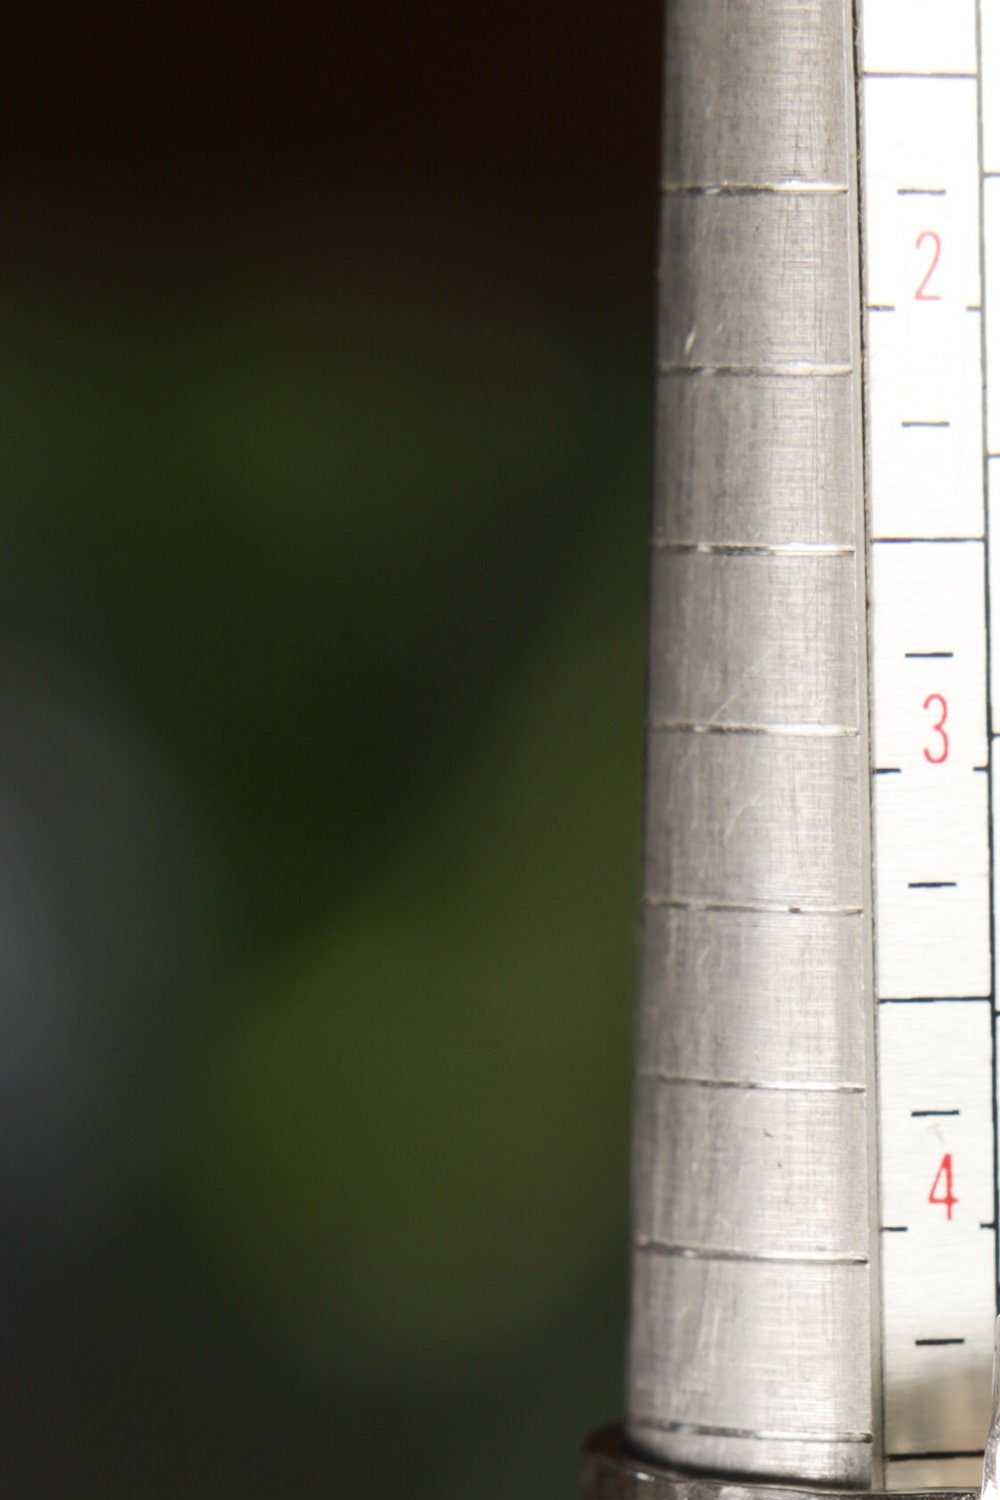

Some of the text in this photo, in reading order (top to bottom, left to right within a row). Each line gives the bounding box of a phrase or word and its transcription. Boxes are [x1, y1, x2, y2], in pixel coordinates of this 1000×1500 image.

[914, 231, 941, 300] 2
[922, 692, 950, 764] 3
[927, 1152, 960, 1221] 4
